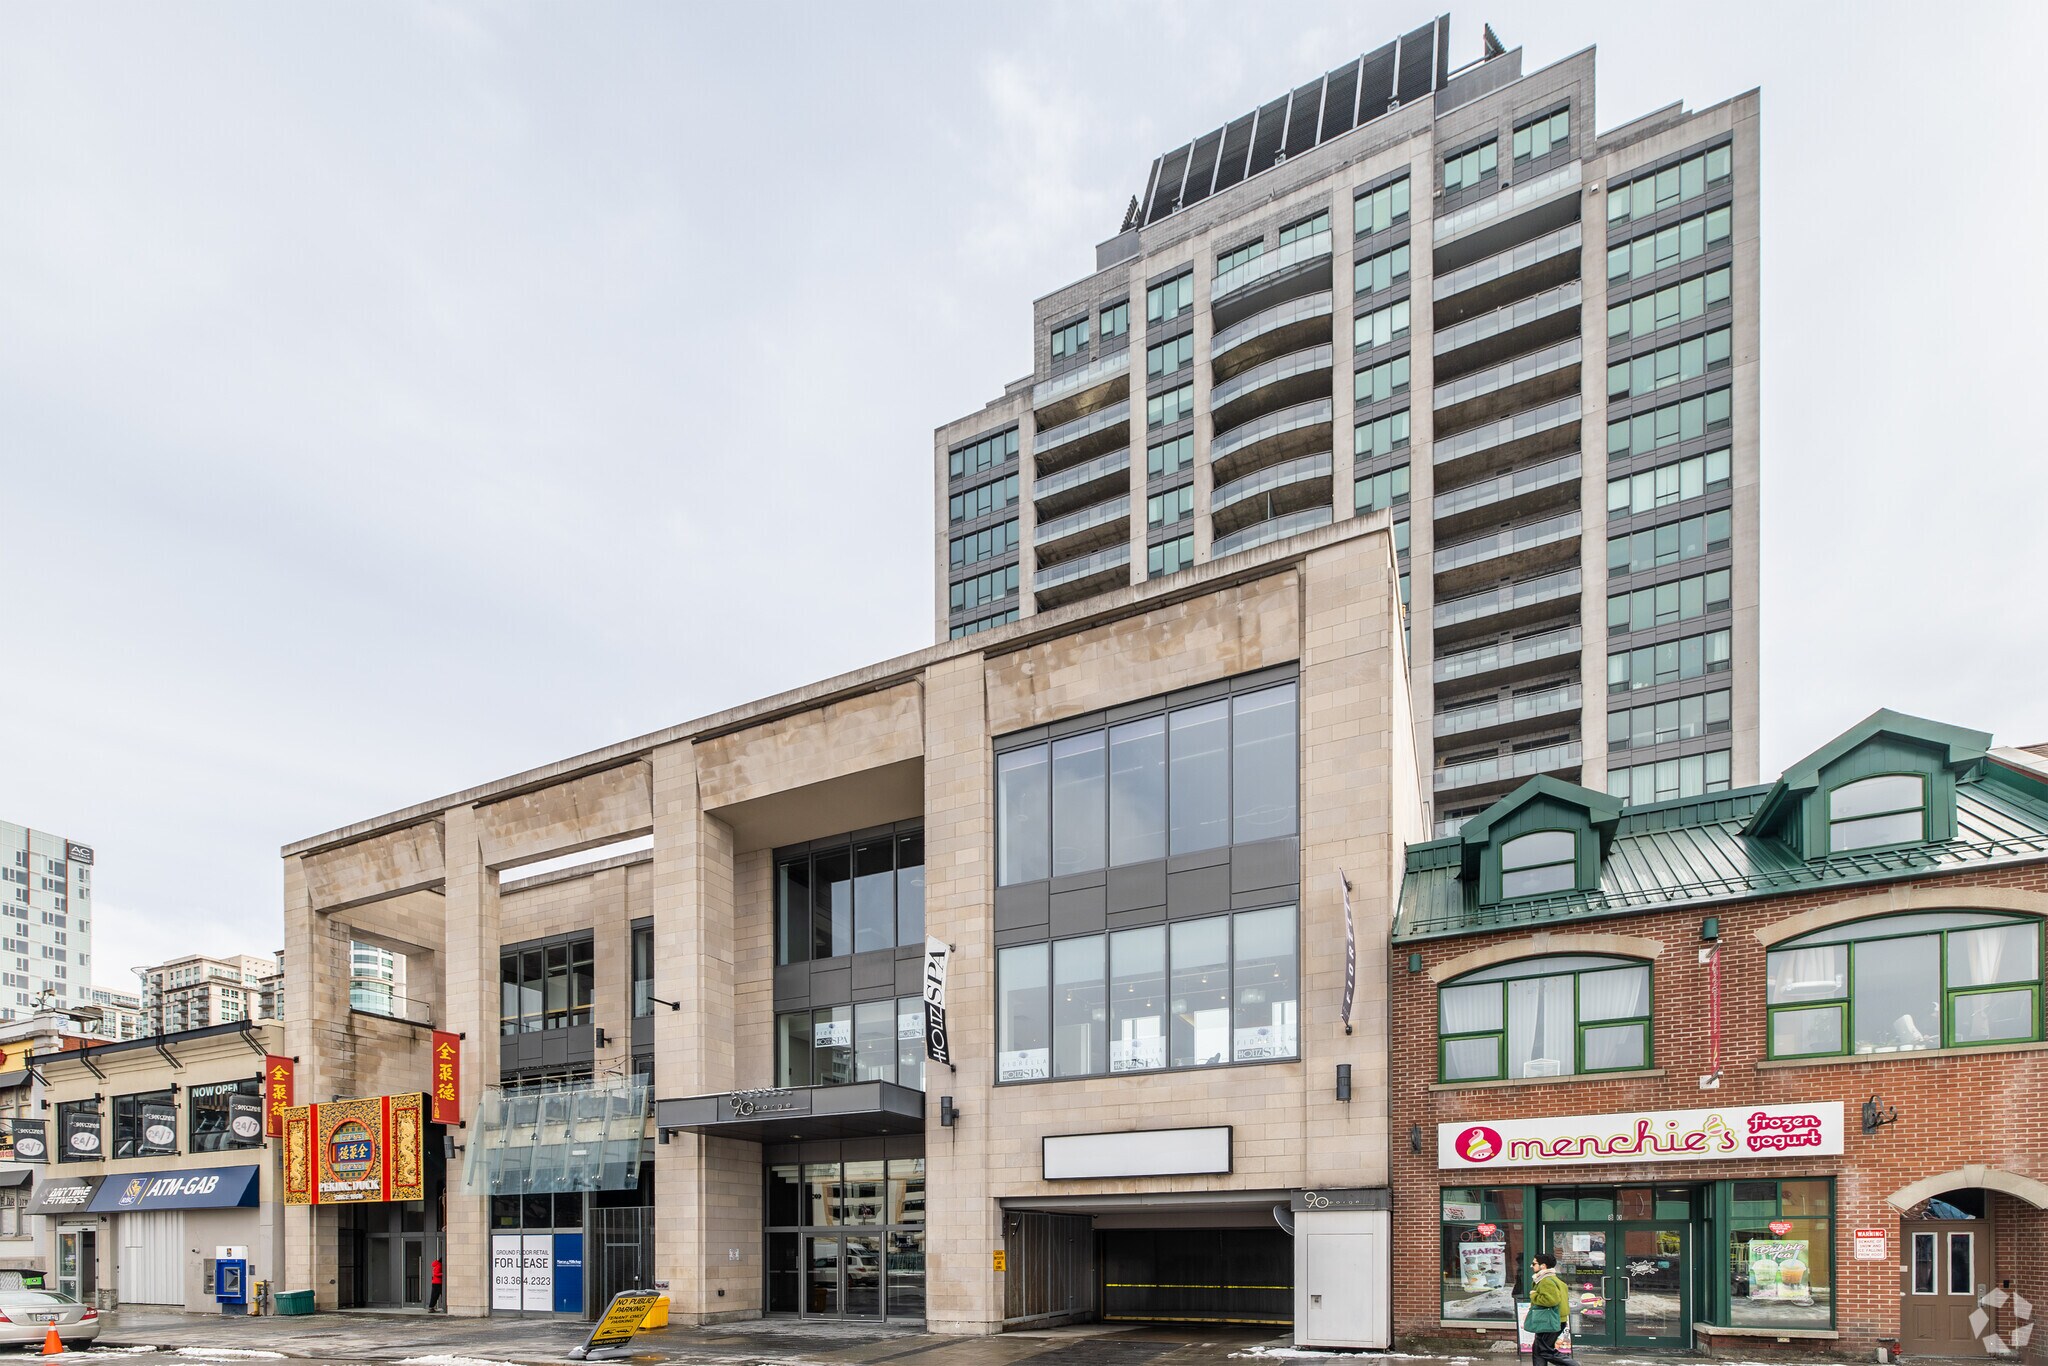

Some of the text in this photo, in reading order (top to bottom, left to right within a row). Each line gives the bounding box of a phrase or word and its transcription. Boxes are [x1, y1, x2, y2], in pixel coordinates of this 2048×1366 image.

[71, 846, 90, 856] AC
[926, 949, 947, 1063] HOLTZ SPA
[832, 1036, 848, 1045] SPA
[1263, 1046, 1291, 1057] SPA
[1136, 1057, 1162, 1068] SPA
[1023, 1068, 1045, 1078] SPA
[192, 1086, 214, 1098] NOW
[730, 1096, 754, 1117] 90
[235, 1121, 258, 1132] 24/7
[1750, 1114, 1818, 1130] frozen
[148, 1129, 171, 1140] 24/7
[1509, 1116, 1737, 1159] menchie's
[73, 1136, 97, 1147] 24/7
[1750, 1133, 1819, 1149] yogurt
[18, 1142, 42, 1152] 24/7
[48, 1186, 93, 1197] ANYTIME
[146, 1176, 220, 1197] ATM-GAB
[319, 1180, 380, 1192] PEKING DUCK
[46, 1196, 87, 1205] FITNESS
[1304, 1192, 1328, 1208] 90
[1462, 1248, 1505, 1257] SHAKES
[1753, 1243, 1805, 1253] Bubble
[1770, 1252, 1792, 1260] Tea
[495, 1258, 548, 1268] FOR LEASE
[496, 1276, 551, 1285] 613.364.2323
